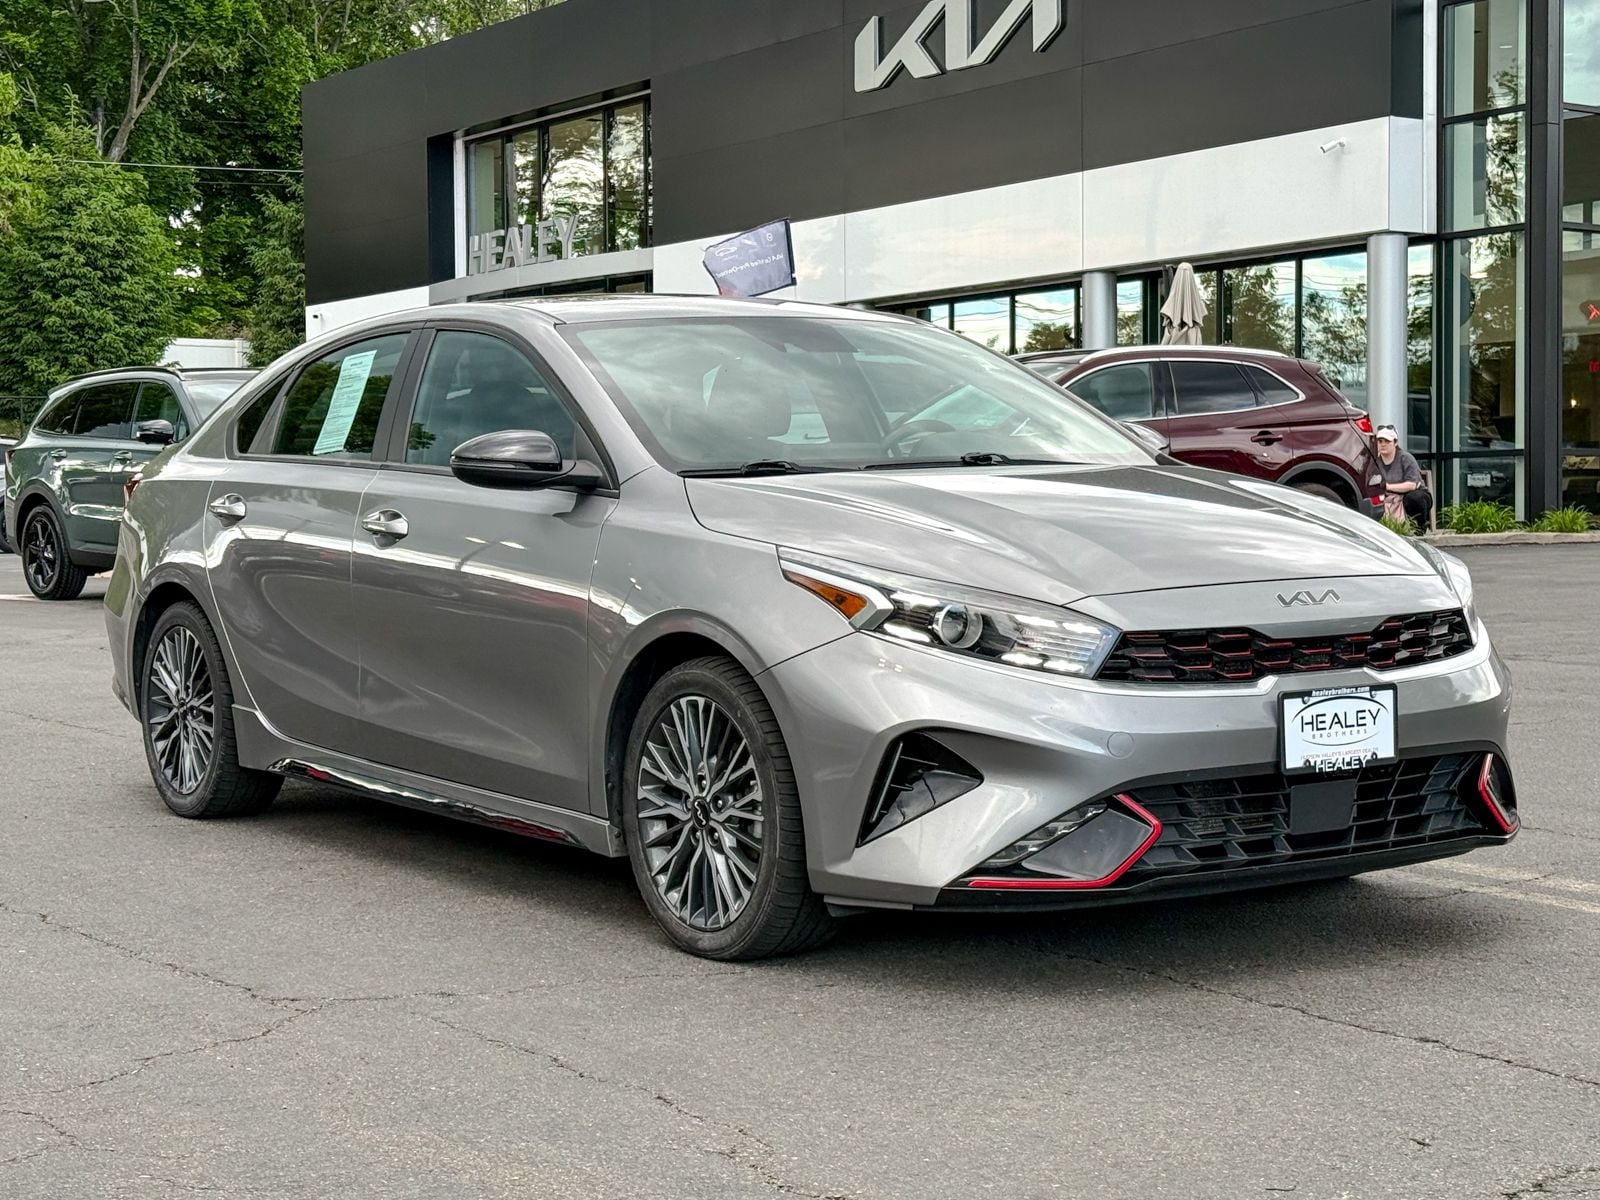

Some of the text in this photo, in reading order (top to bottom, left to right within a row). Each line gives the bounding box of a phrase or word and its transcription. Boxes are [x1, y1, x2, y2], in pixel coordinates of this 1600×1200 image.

[469, 214, 580, 276] HEALEY
[1275, 588, 1341, 606] KIA
[1311, 686, 1370, 697] healeybrothers.com
[1301, 708, 1380, 733] HEALEY
[1311, 728, 1367, 739] BROTHERS
[1315, 754, 1368, 773] HEALEY
